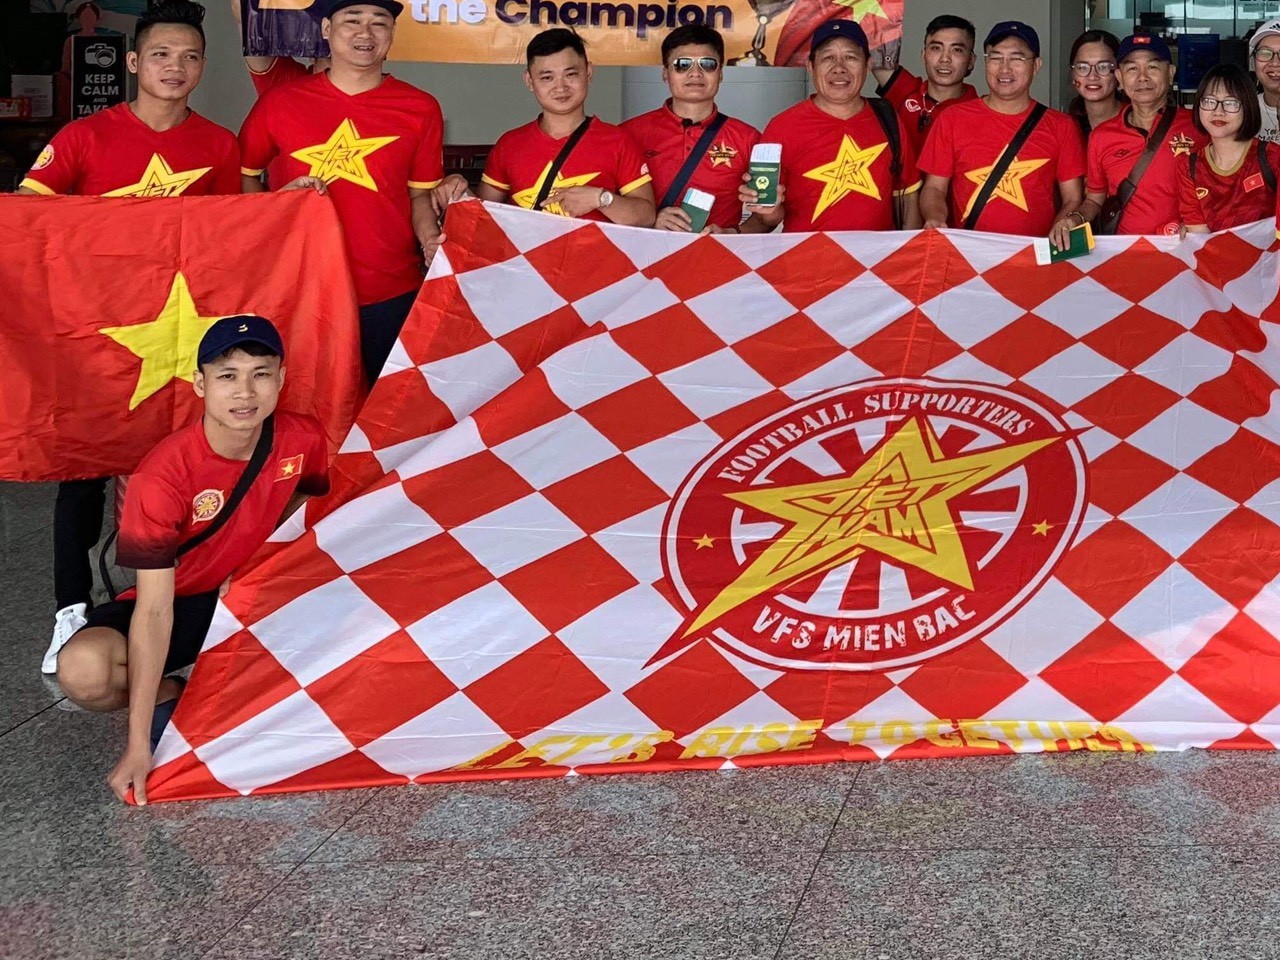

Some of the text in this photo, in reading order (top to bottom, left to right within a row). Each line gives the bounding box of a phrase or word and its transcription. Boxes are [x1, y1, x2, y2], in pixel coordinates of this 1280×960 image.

[82, 85, 119, 96] CALM
[85, 74, 115, 84] KEEP
[717, 391, 1037, 483] FOOTBALL SUPPORTERS
[752, 594, 977, 652] VFS MIEN BAC
[678, 719, 825, 760] RISE
